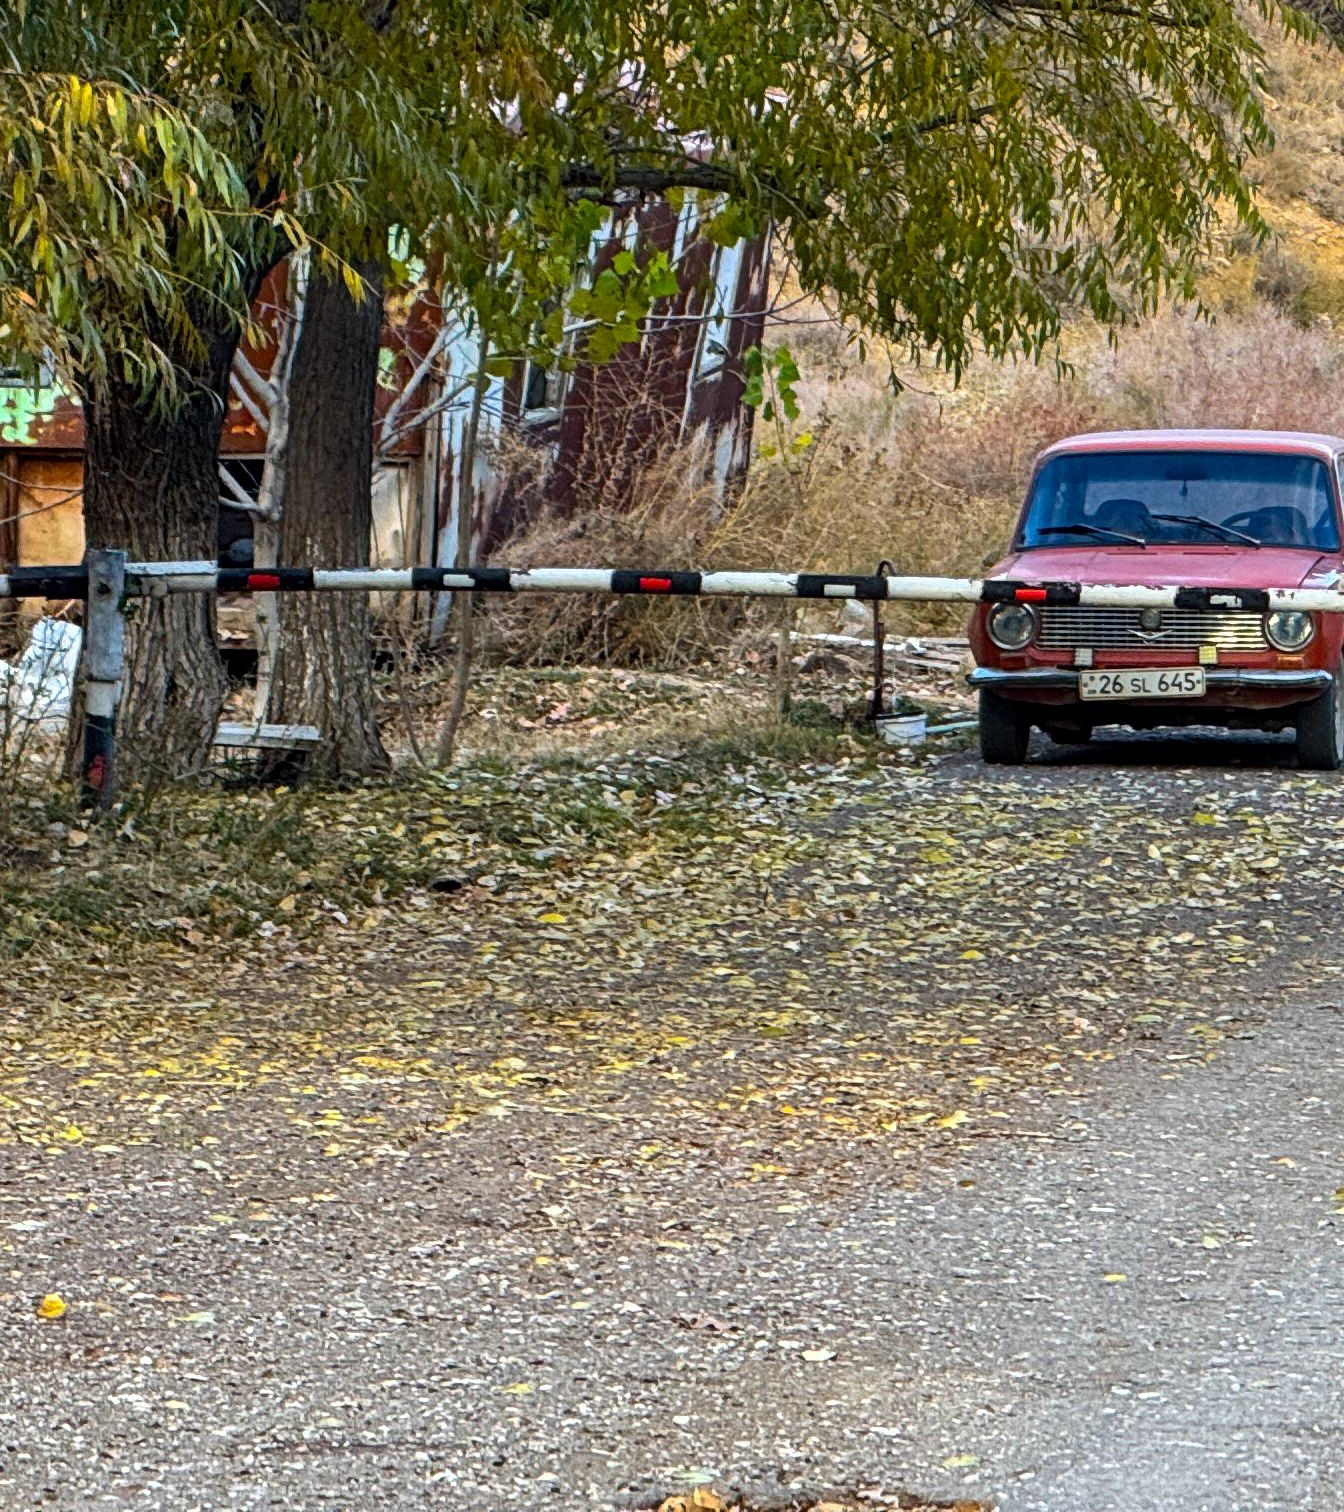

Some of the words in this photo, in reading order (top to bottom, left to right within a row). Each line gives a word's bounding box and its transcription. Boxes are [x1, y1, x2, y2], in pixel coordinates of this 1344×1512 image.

[1099, 674, 1124, 694] 26
[1130, 678, 1151, 693] SL
[1157, 672, 1196, 692] 645
